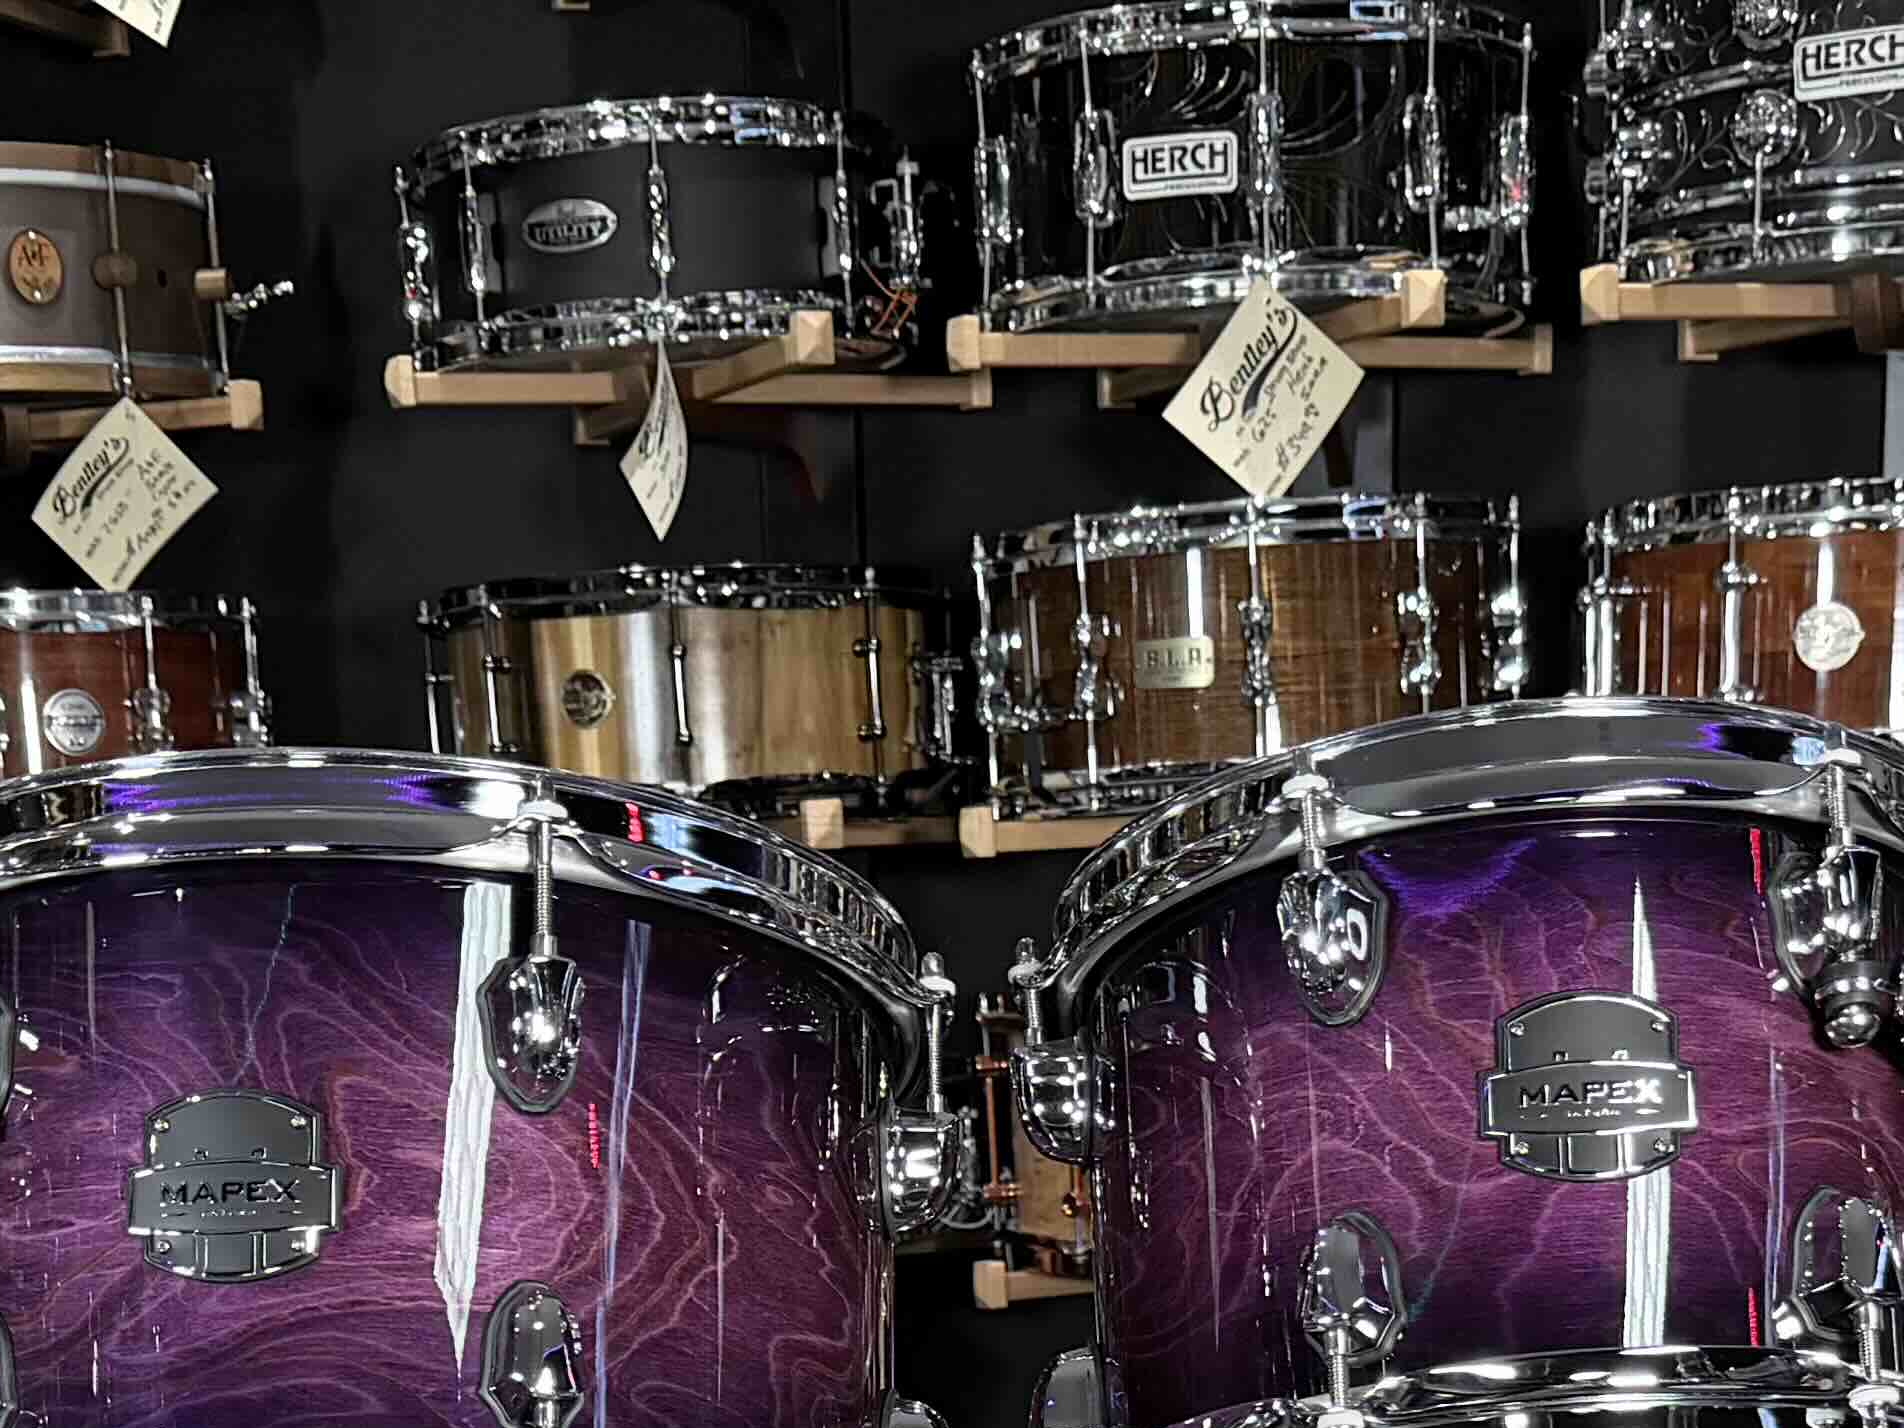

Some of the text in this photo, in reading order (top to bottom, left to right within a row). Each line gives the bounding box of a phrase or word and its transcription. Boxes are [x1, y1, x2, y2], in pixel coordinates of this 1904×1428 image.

[1132, 142, 1228, 184] HERCH
[1199, 305, 1296, 433] Bentley's
[52, 437, 129, 525] Bentley's
[1520, 1078, 1665, 1113] MAPEX
[160, 1177, 302, 1207] MAPEX
